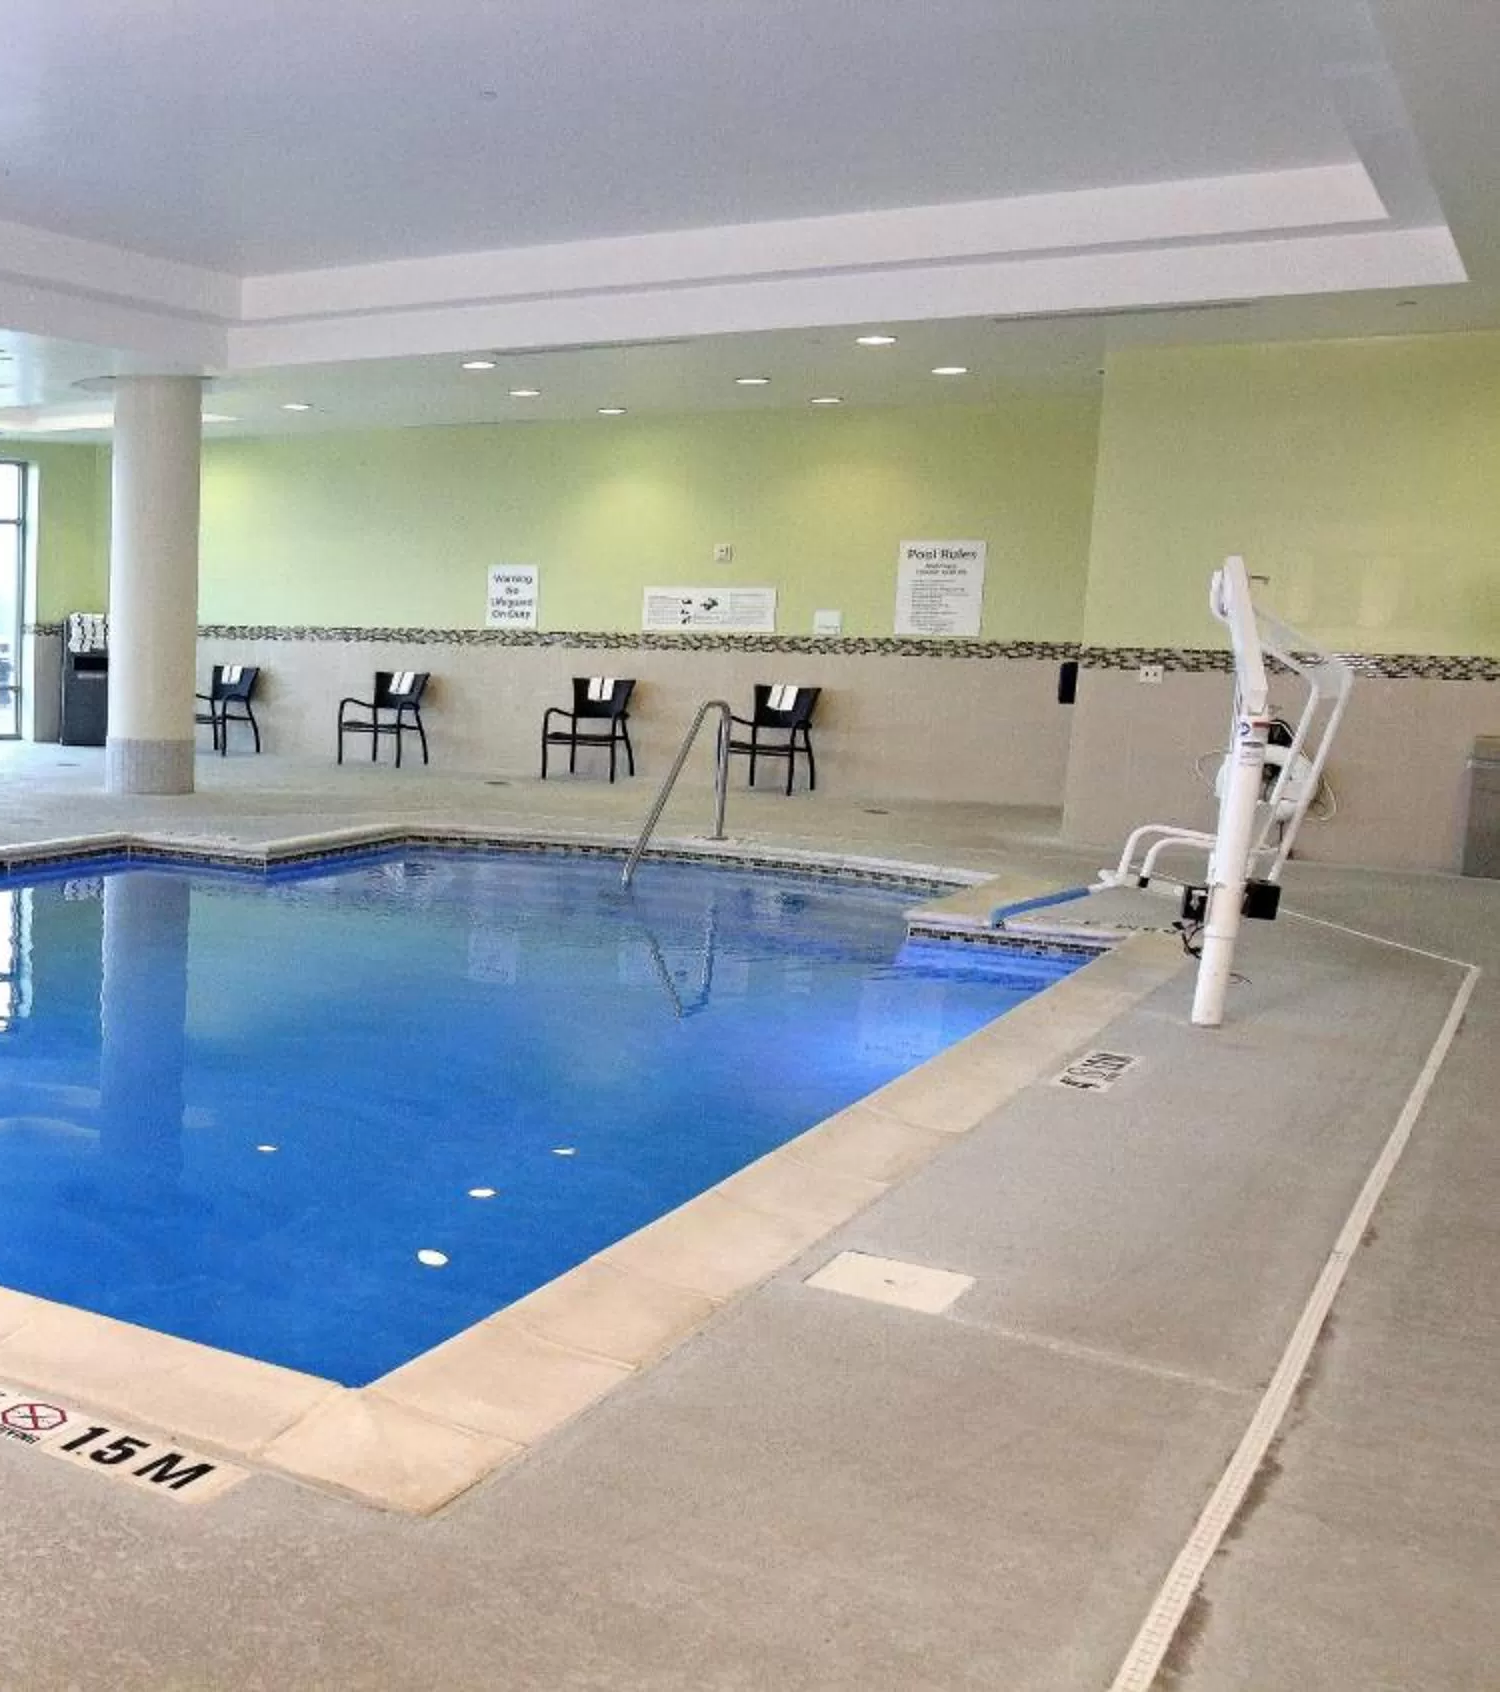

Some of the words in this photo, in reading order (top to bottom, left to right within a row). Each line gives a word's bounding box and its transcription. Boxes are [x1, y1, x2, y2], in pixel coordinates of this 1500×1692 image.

[907, 549, 937, 559] Pool
[941, 548, 977, 559] Rules
[493, 573, 533, 585] Warning
[60, 1426, 152, 1465] 1.5
[132, 1453, 216, 1490] M
